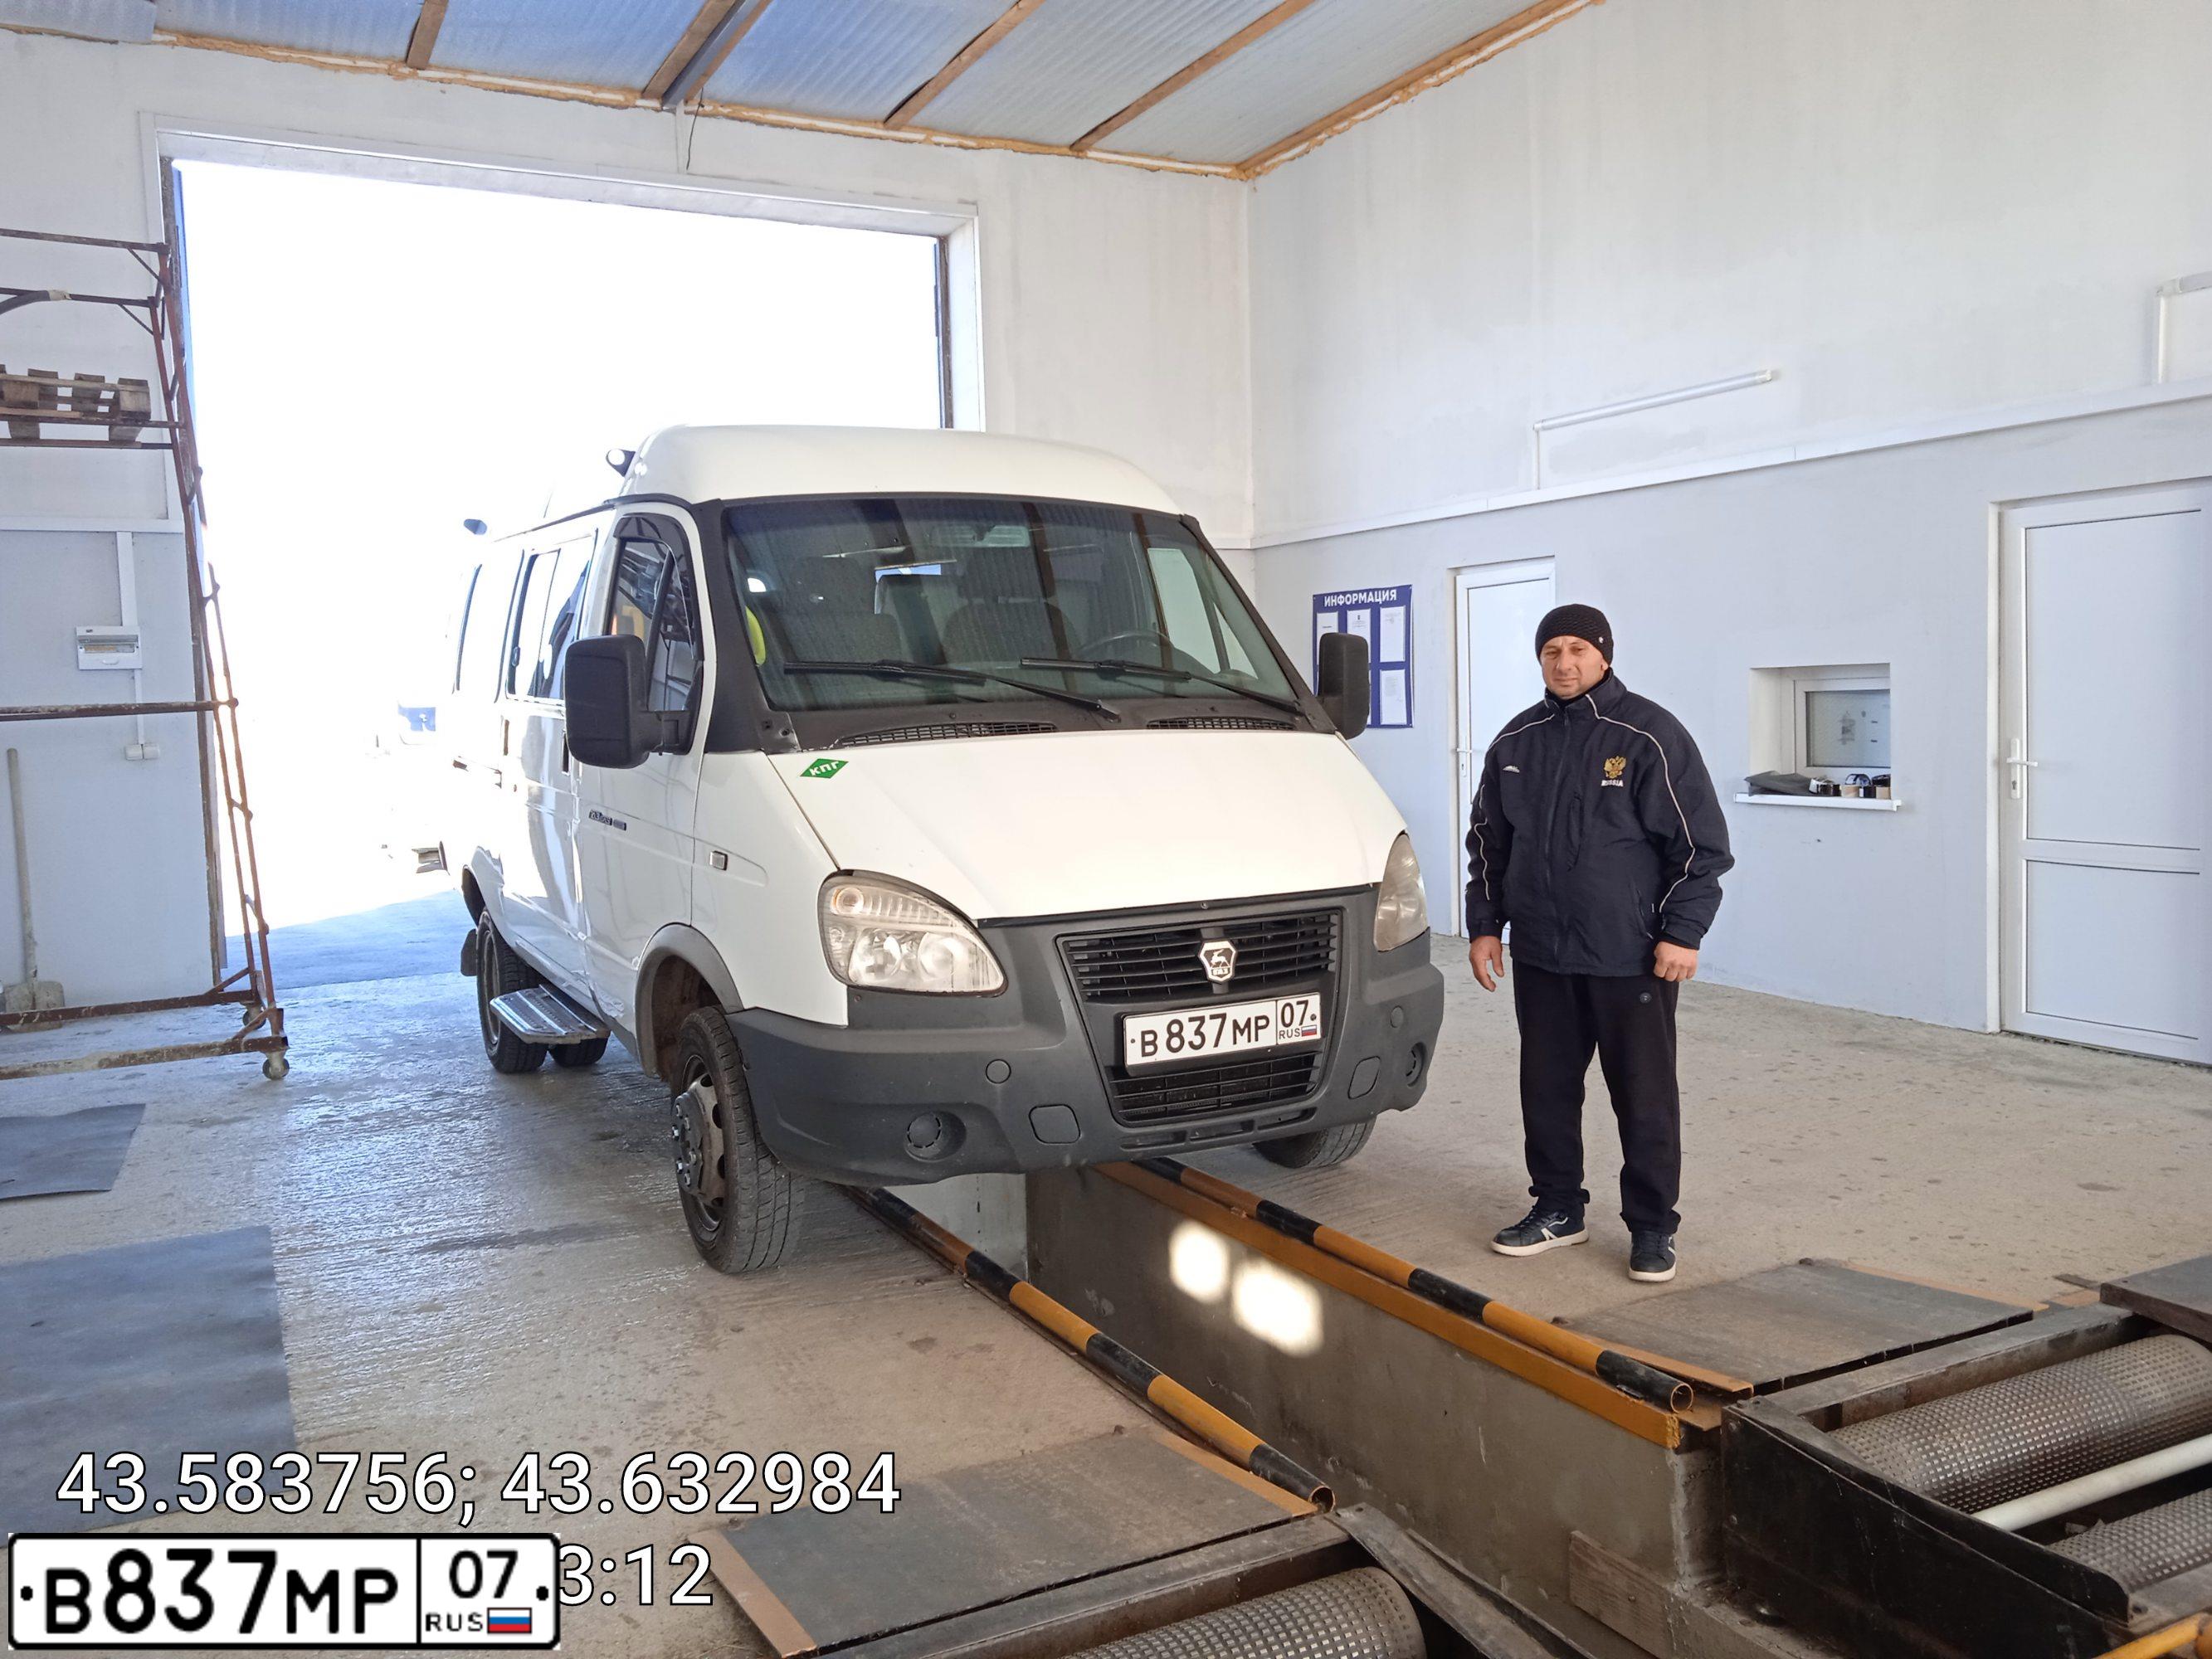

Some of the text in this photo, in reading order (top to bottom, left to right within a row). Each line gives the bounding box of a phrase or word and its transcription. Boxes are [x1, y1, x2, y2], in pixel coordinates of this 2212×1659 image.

[1324, 589, 1397, 607] ИНФОРМАЦИЯ
[809, 761, 839, 776] КПГ
[1280, 1000, 1309, 1028] 07
[1279, 1028, 1301, 1040] RUS
